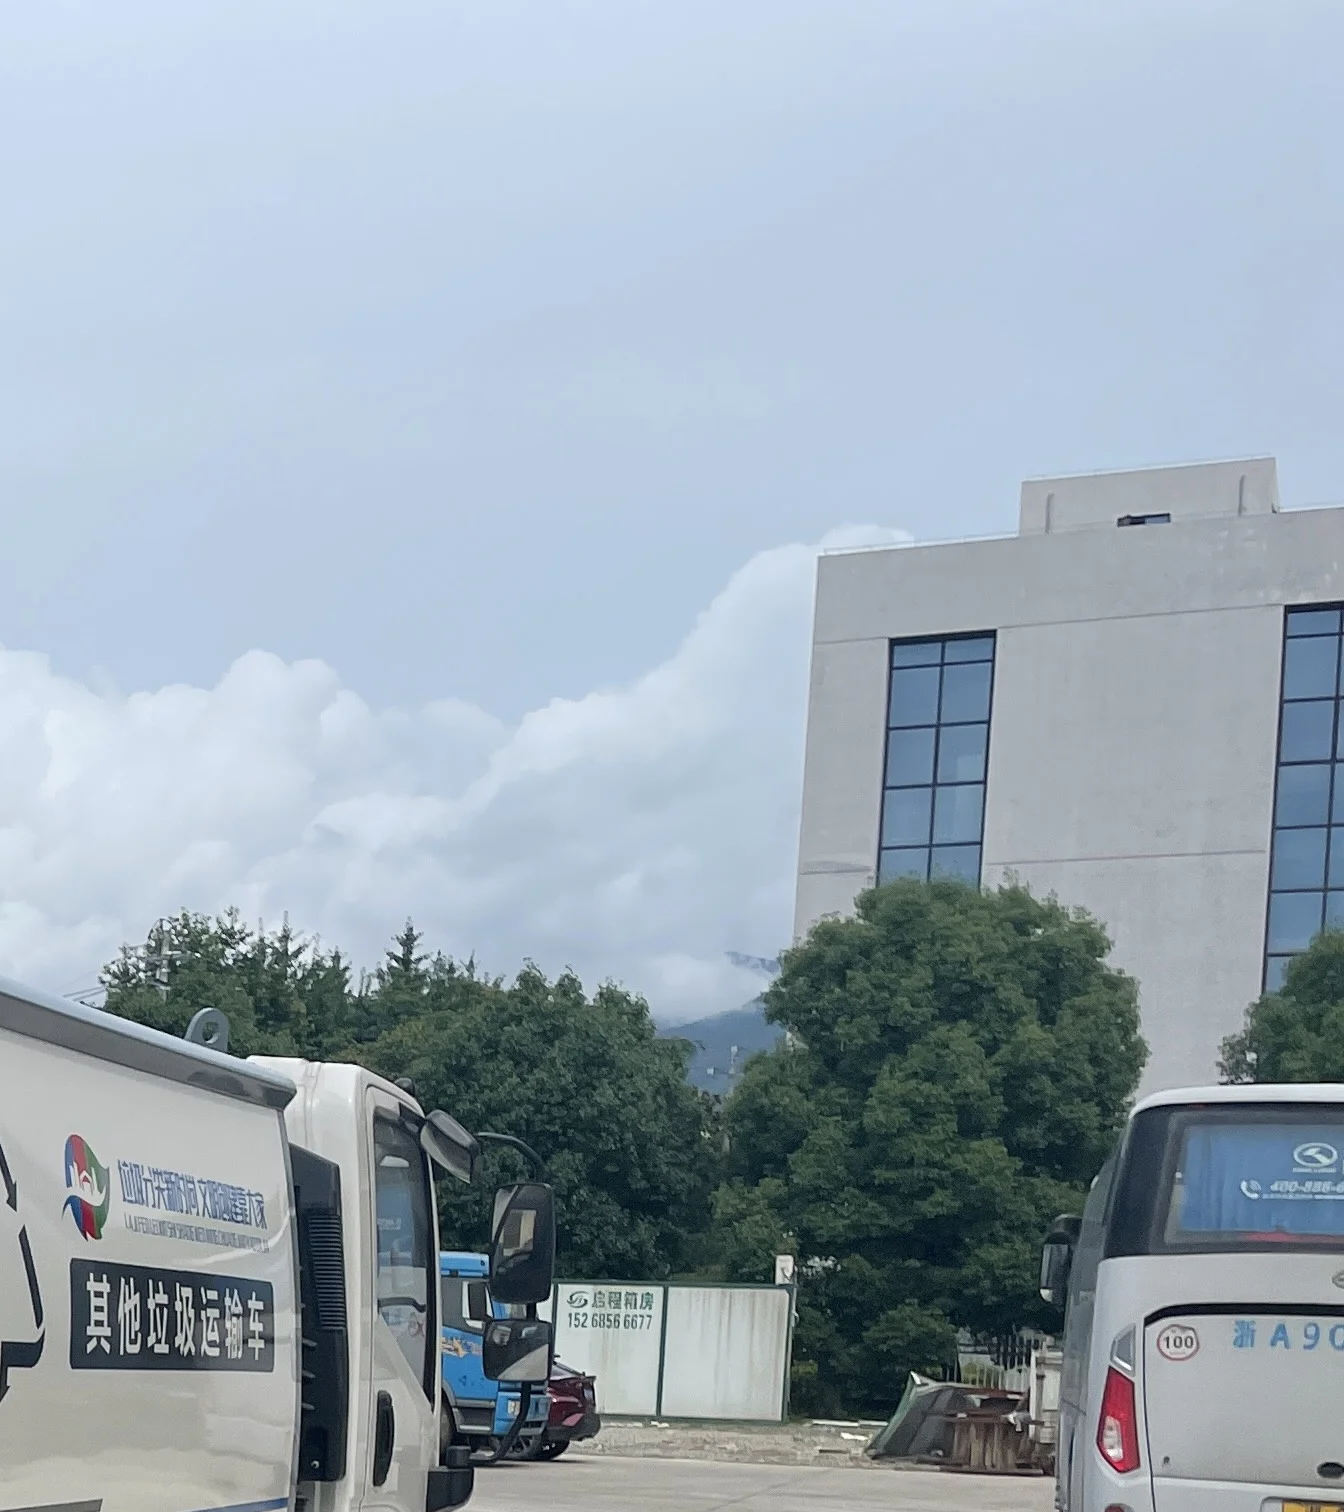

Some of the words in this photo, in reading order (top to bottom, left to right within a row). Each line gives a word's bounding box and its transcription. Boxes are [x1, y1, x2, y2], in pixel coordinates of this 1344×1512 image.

[86, 1272, 266, 1361] 其他垃圾运输车
[568, 1312, 588, 1329] 152
[591, 1312, 621, 1329] 6856
[623, 1314, 653, 1330] 6677
[1164, 1335, 1194, 1349] 100
